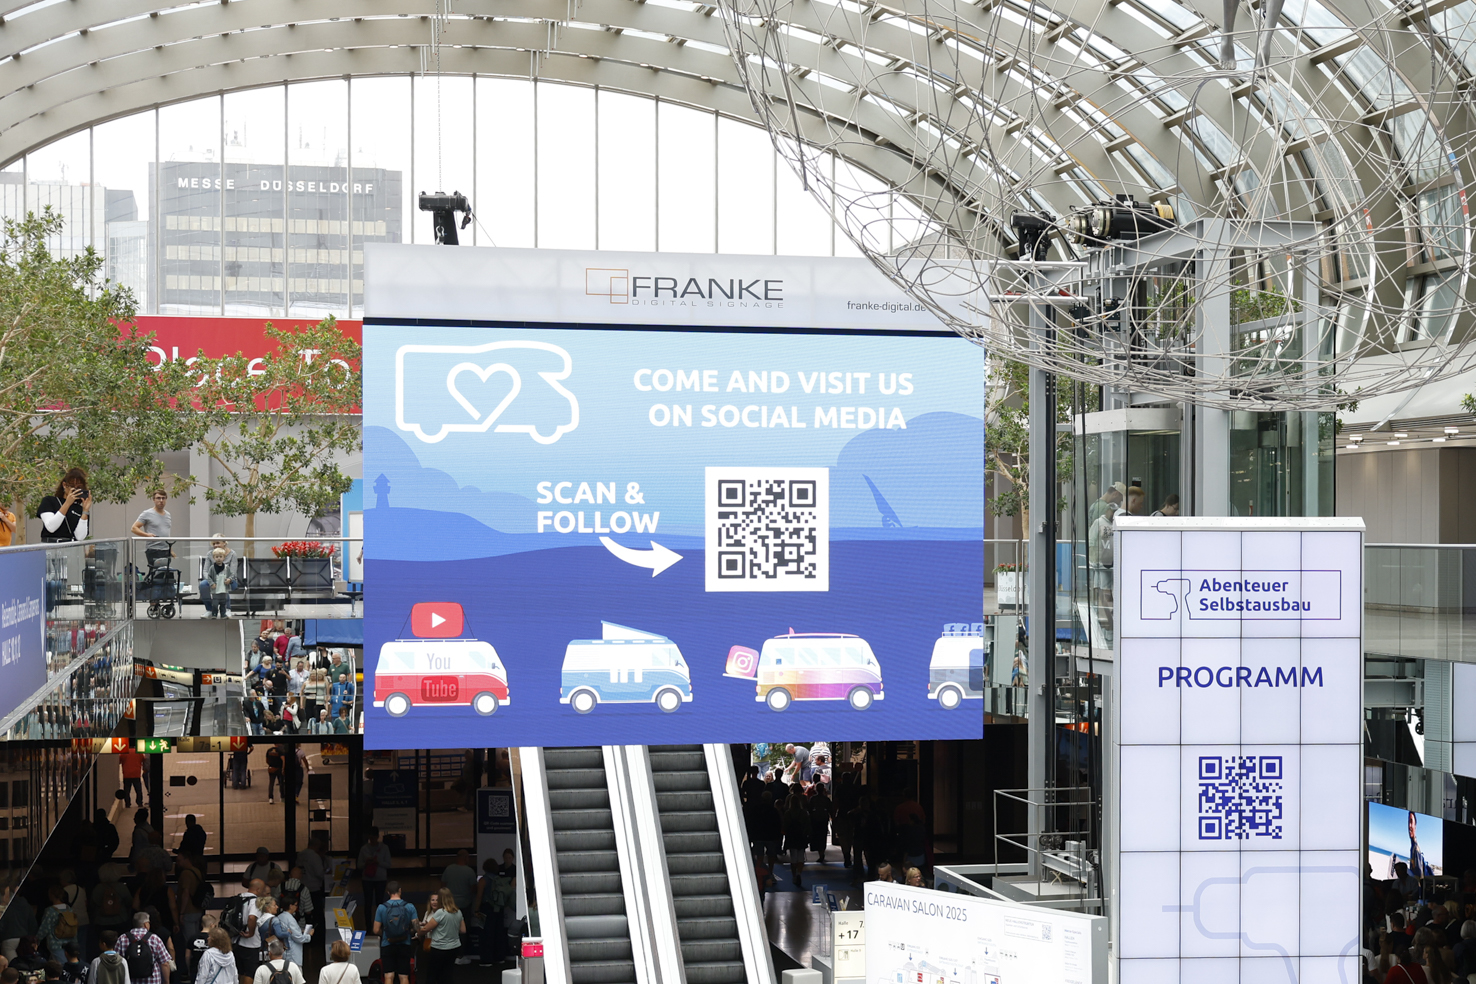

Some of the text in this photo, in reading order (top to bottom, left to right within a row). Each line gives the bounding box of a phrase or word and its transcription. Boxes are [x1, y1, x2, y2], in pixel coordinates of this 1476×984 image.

[178, 178, 373, 194] MESSE DÜSSELDORF
[632, 276, 784, 301] FRANKE
[707, 301, 784, 309] SIGNAGE
[847, 300, 927, 313] franke-digital.de
[633, 369, 914, 396] COME AND VISIT US
[648, 404, 907, 430] ON SOCIAL MEDIA
[536, 481, 646, 504] SCAN &
[537, 511, 660, 534] FOLLOW
[1199, 578, 1289, 592] Abenteuer
[1199, 597, 1311, 612] Selbstausbau
[427, 652, 451, 671] You
[1158, 666, 1324, 688] PROGRAMM
[424, 680, 457, 699] Tube
[867, 892, 967, 922] CARAVAN SALON 2025
[847, 930, 859, 939] 17
